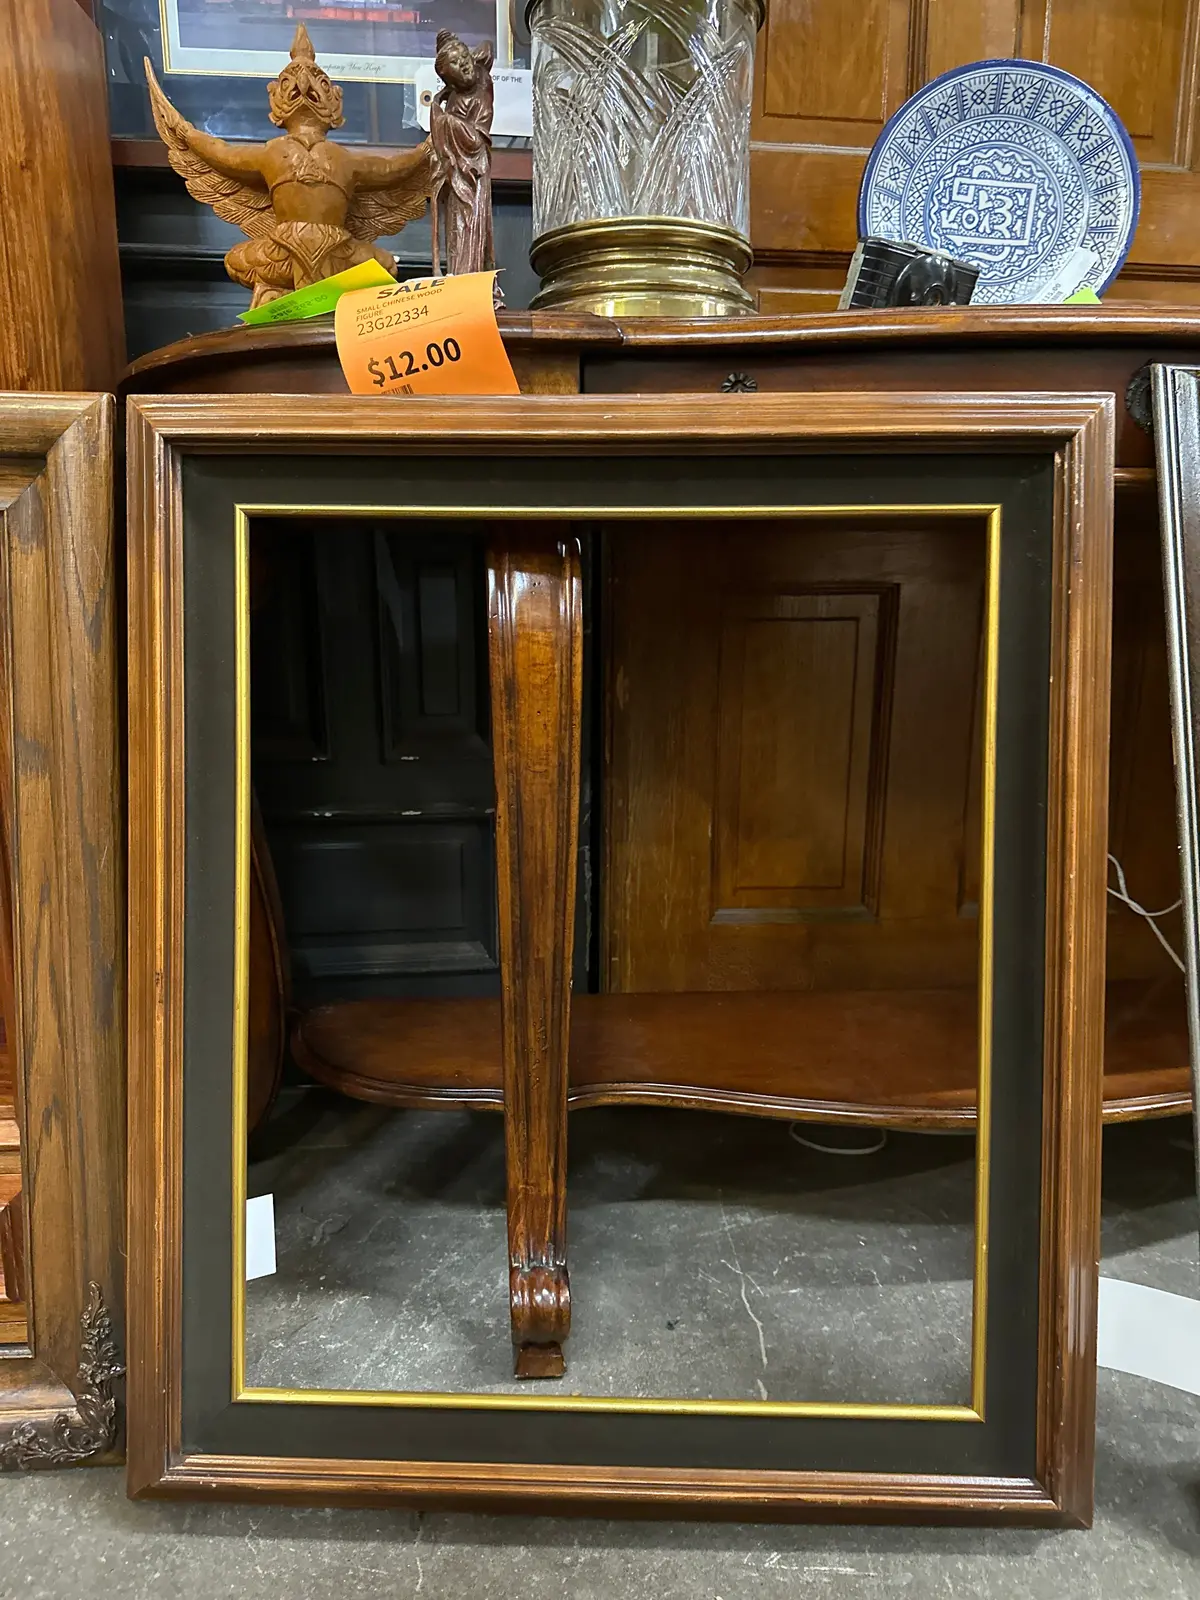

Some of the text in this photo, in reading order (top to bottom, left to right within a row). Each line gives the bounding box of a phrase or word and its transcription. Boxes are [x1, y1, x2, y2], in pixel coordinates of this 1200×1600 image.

[322, 64, 345, 73] mpany
[510, 76, 523, 84] THE
[376, 277, 446, 299] SALE
[356, 288, 443, 315] SMALL CHINESE WOOD
[356, 309, 384, 322] FIGURE
[357, 305, 429, 337] 23G22334
[367, 337, 461, 387] $12.00
